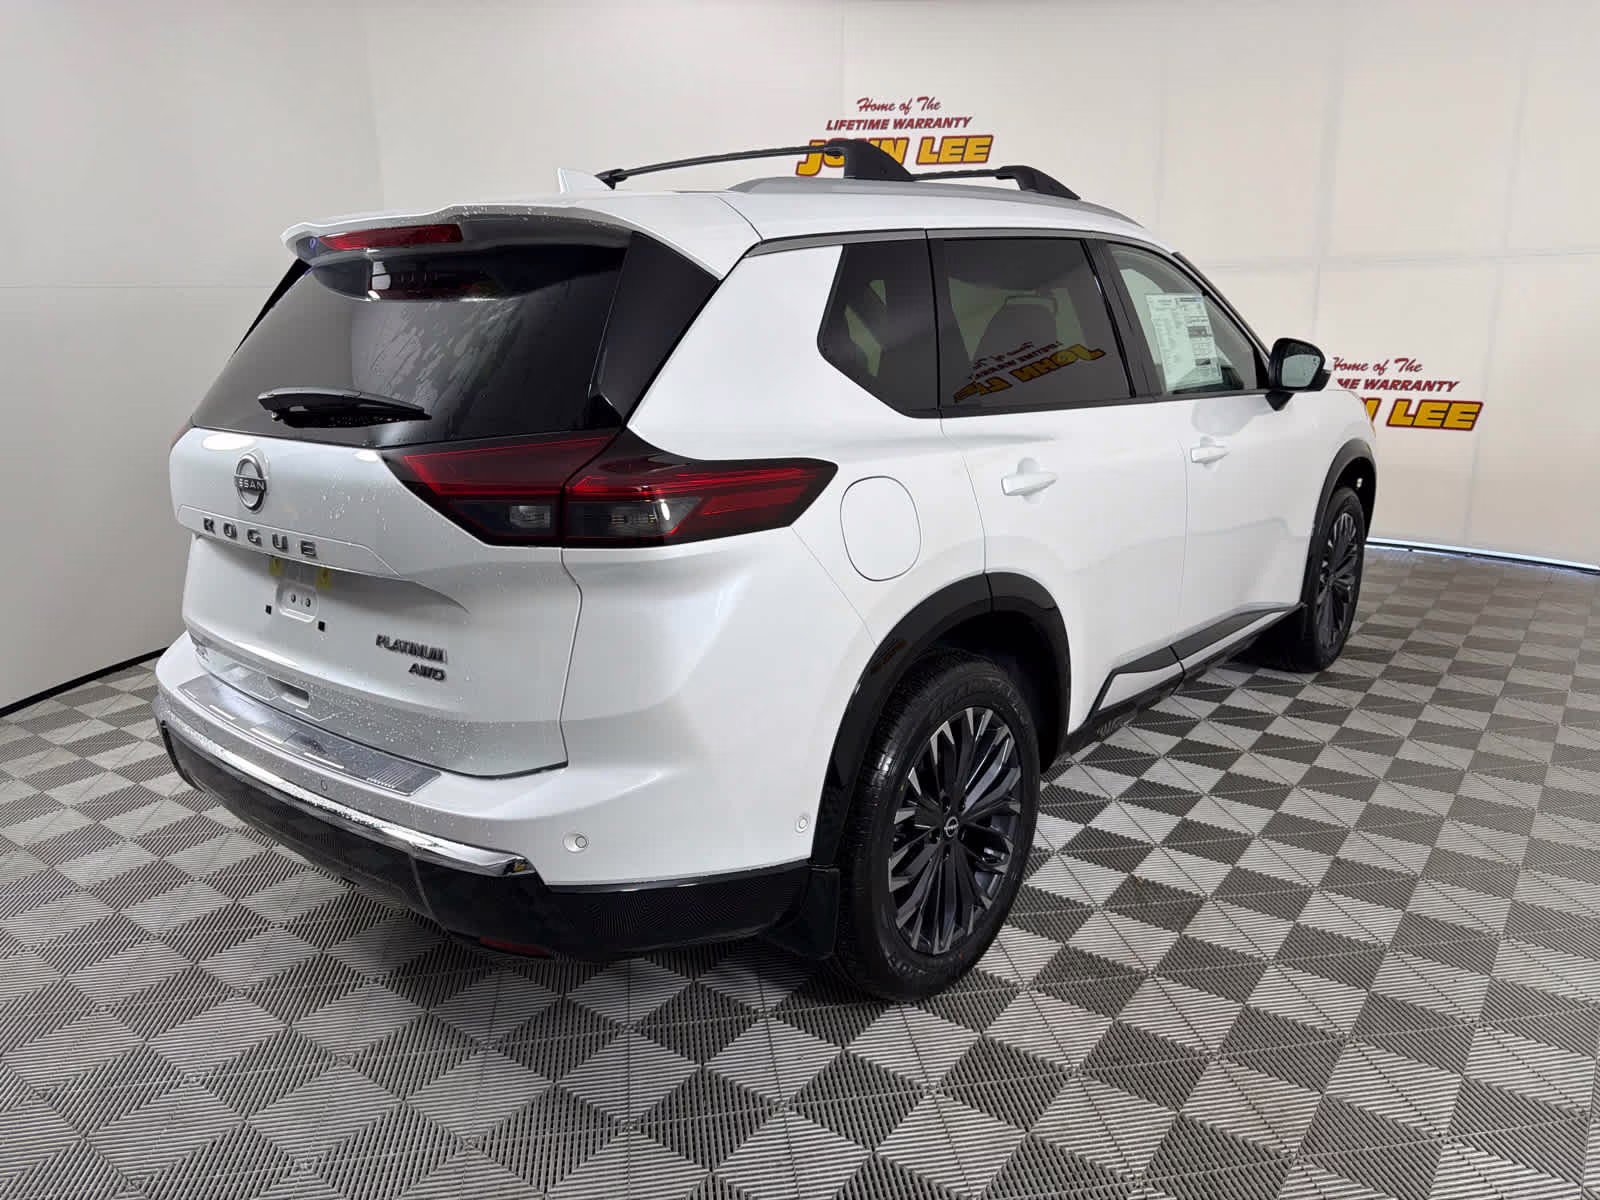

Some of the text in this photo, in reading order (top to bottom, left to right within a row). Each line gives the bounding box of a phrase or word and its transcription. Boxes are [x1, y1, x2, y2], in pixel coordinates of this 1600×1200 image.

[857, 96, 941, 115] Home of The
[826, 117, 973, 131] LIFETIME WARRANTY
[796, 135, 994, 176] JN LEE
[1373, 359, 1389, 375] of
[1394, 358, 1423, 373] The
[1363, 378, 1460, 392] WARRANTY
[1386, 398, 1484, 431] LEE
[236, 478, 265, 491] SSAN
[203, 517, 318, 558] ROGUE
[376, 633, 446, 664] PLATINUM
[408, 662, 446, 681] AWD
